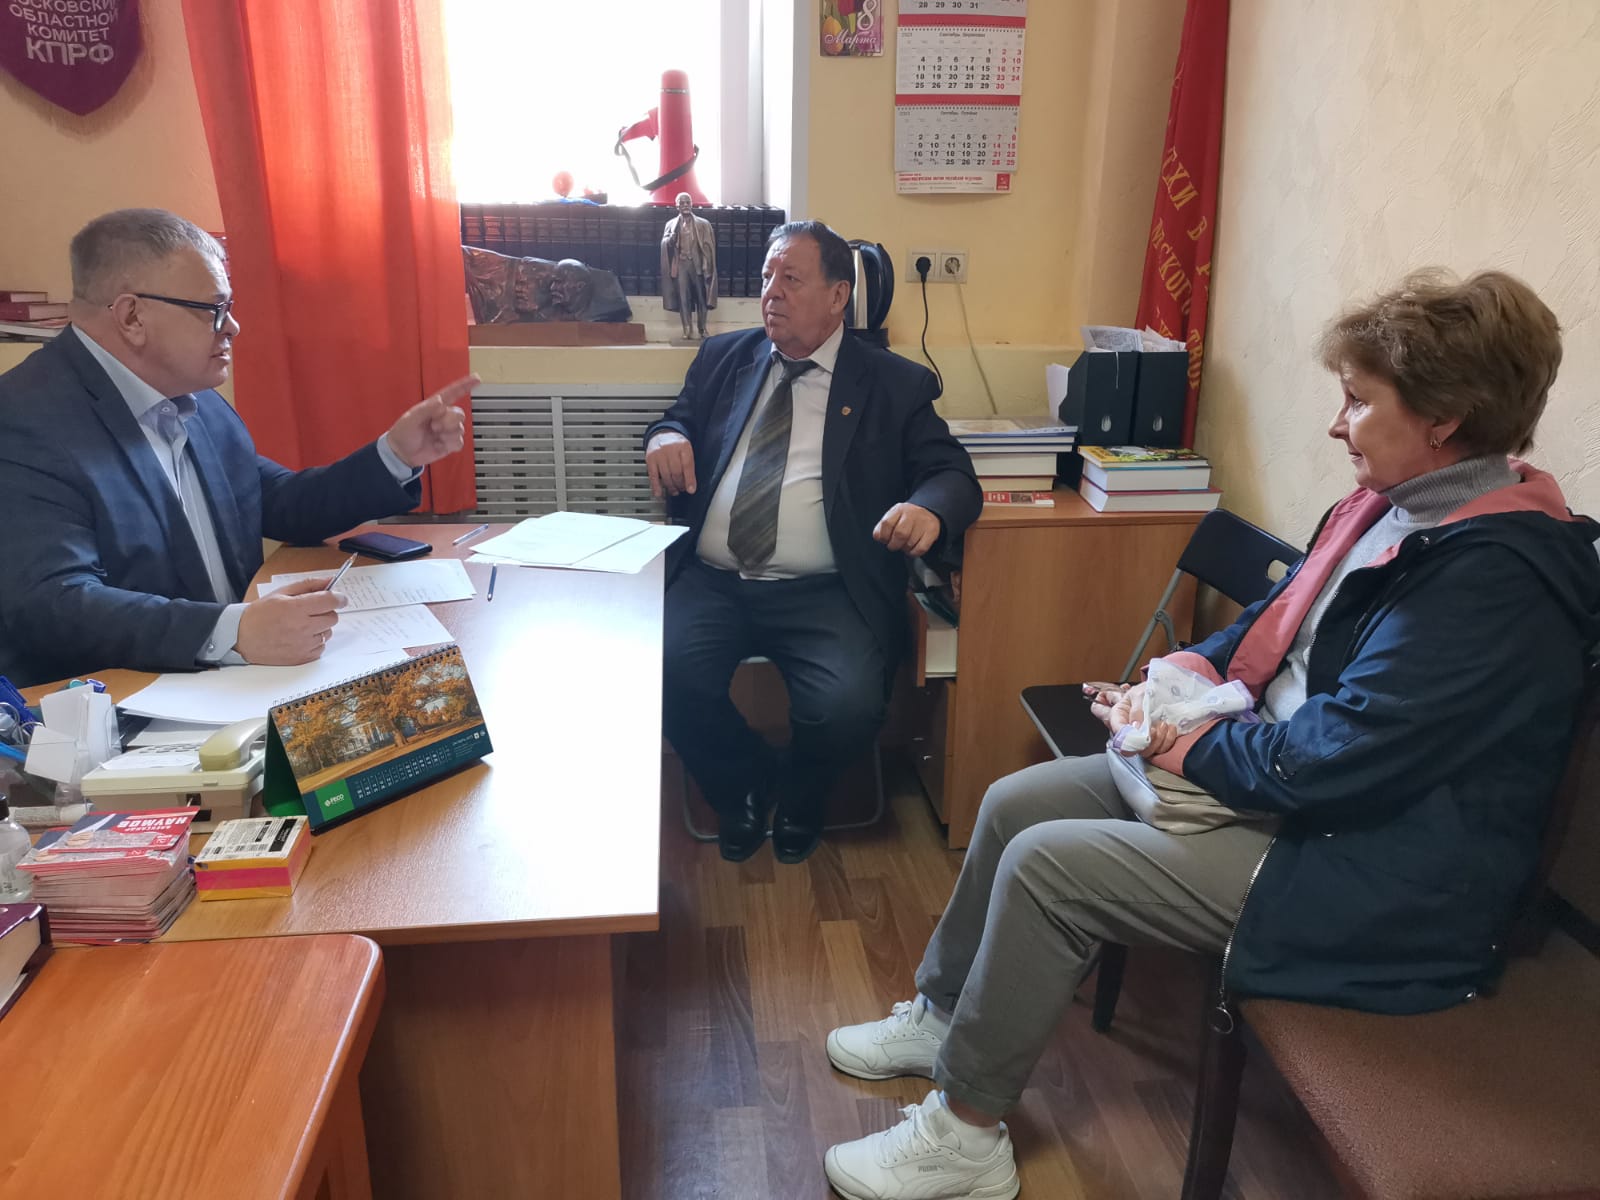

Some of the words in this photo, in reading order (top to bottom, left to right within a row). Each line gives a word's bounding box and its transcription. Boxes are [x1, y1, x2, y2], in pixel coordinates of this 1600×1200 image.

[857, 0, 876, 30] 8
[27, 23, 110, 42] КОМИТЕТ
[825, 29, 877, 50] Марта
[25, 36, 114, 65] КПРФ
[117, 817, 188, 828] НАУМОВ
